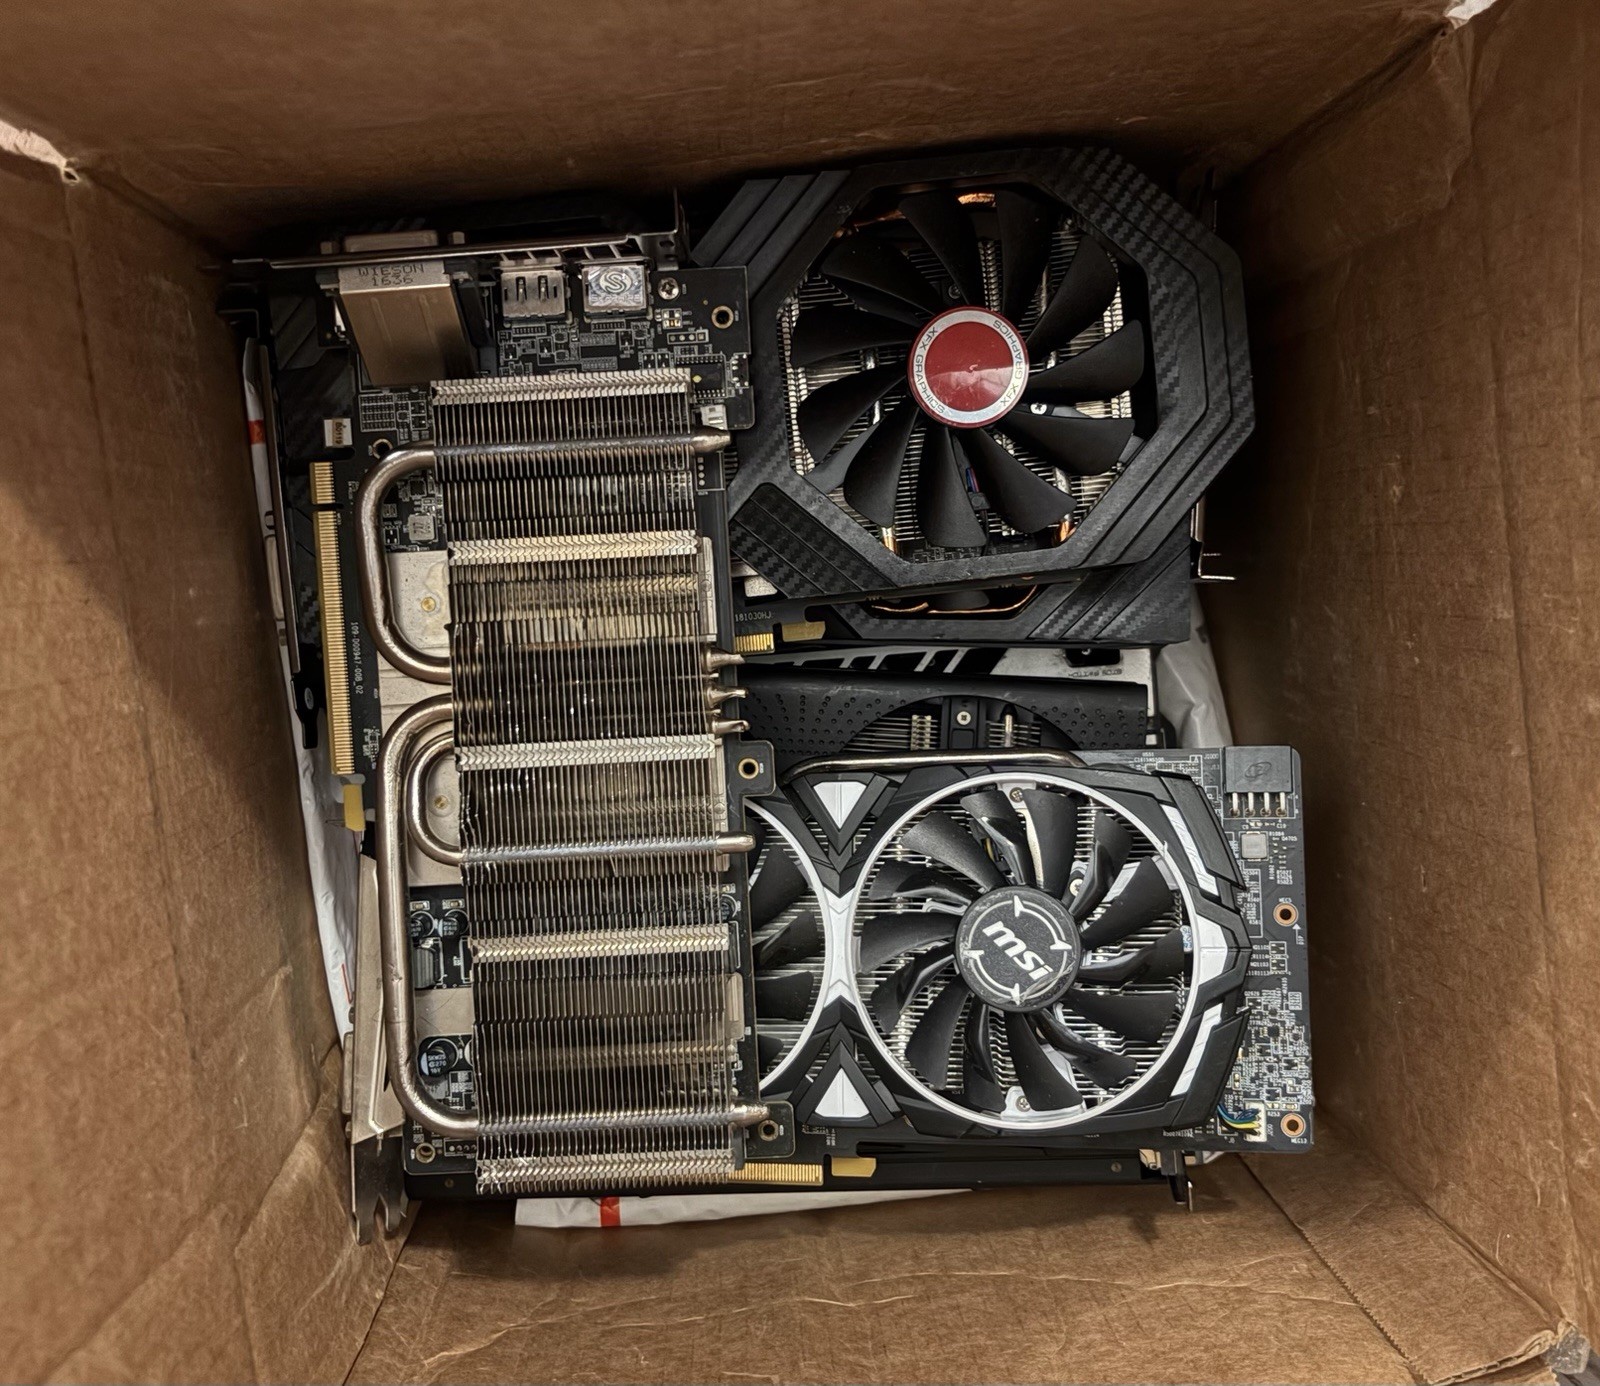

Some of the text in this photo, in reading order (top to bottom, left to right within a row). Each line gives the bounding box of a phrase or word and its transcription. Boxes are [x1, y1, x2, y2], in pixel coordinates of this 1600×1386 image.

[358, 263, 425, 277] WIESON
[372, 274, 414, 287] 1636
[915, 326, 946, 414] XFX GRAPHICS
[992, 319, 1023, 407] XFX GRAPHICS
[982, 920, 1054, 981] msi
